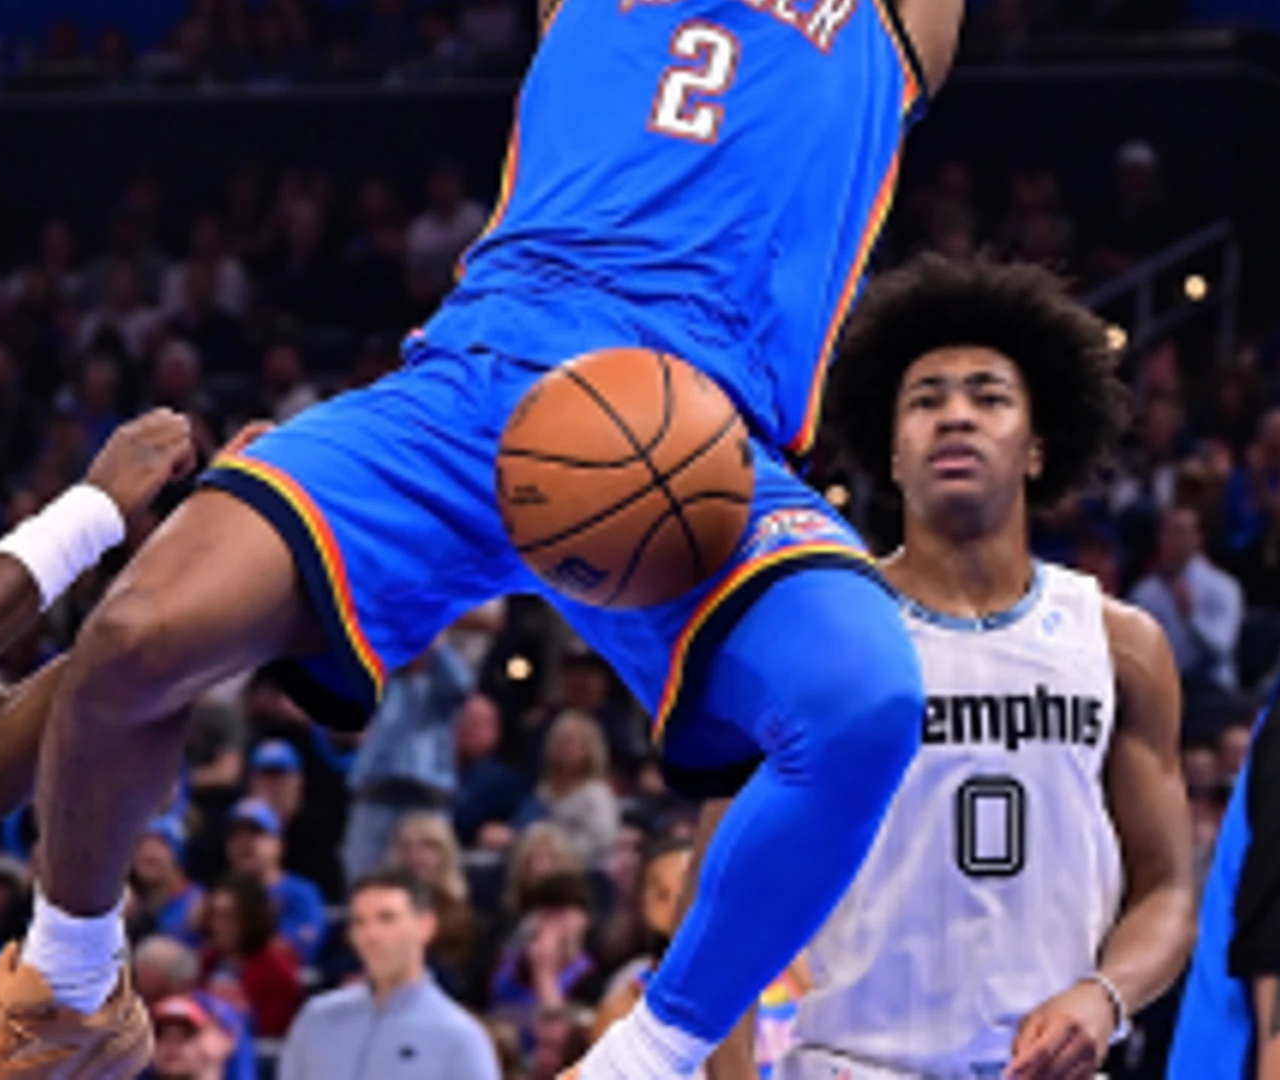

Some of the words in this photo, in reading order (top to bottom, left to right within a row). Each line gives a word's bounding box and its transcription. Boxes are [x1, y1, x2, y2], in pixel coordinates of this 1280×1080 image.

[647, 19, 741, 145] 2
[920, 684, 1104, 752] emphis
[955, 775, 1026, 879] 0
